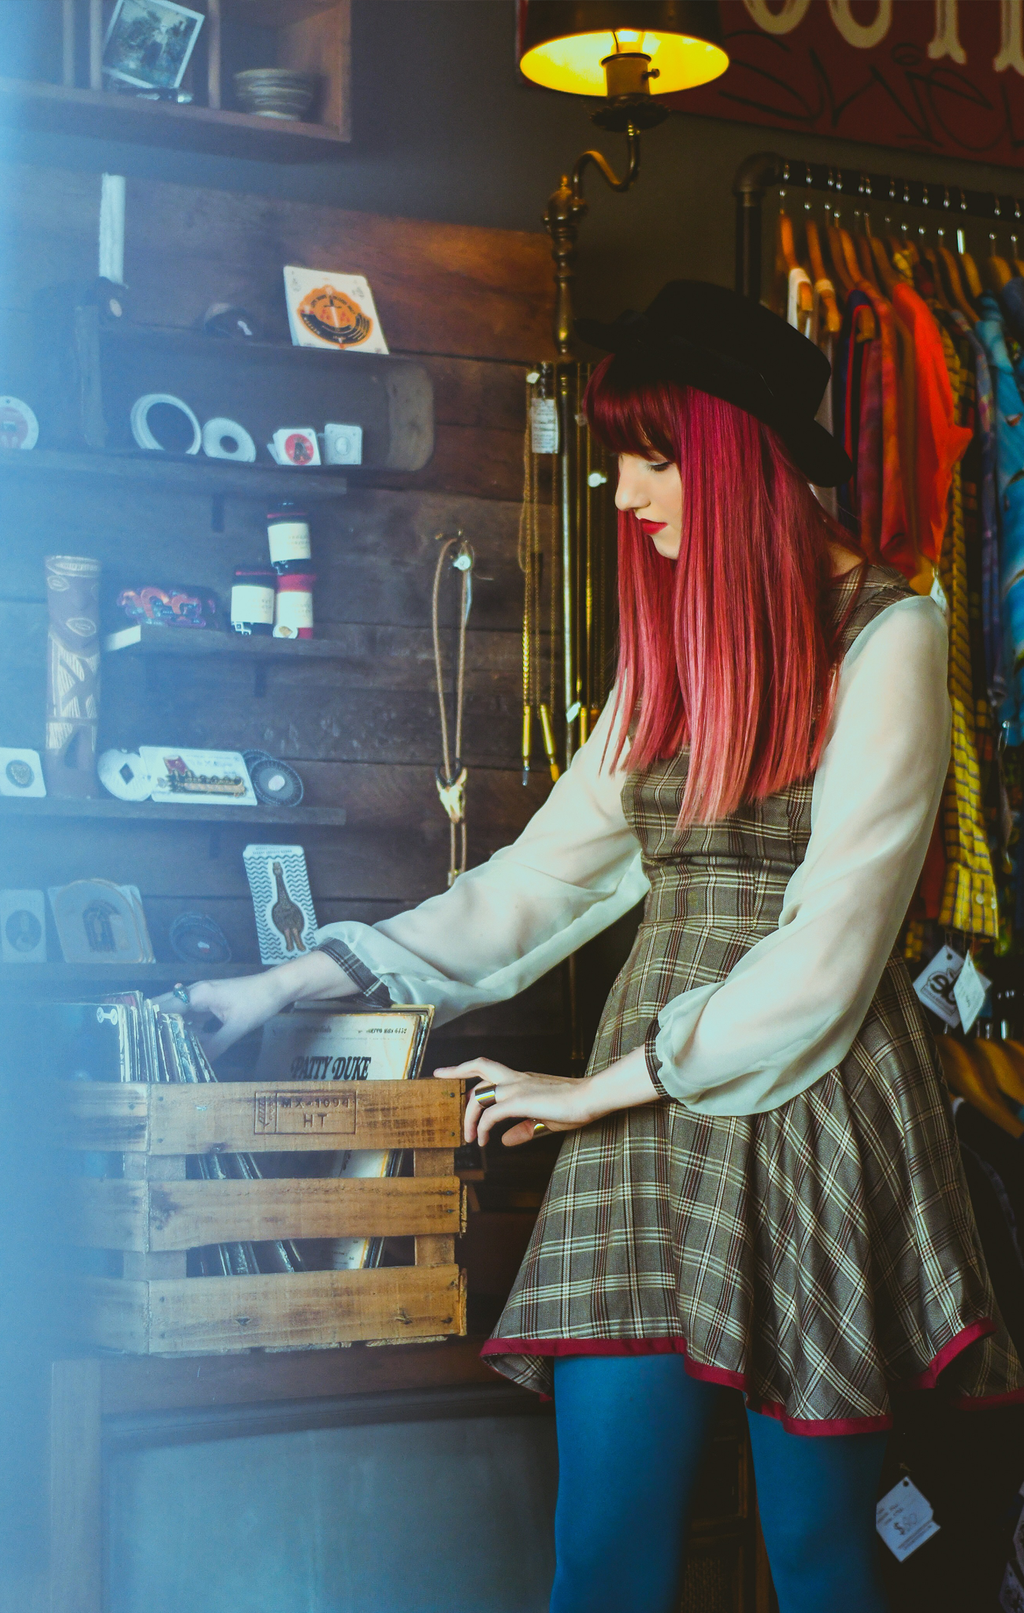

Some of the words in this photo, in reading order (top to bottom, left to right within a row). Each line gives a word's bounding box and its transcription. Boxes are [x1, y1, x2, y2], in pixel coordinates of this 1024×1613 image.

[291, 1056, 333, 1080] PATTY
[332, 1056, 371, 1080] DUKE
[303, 1112, 328, 1128] HT
